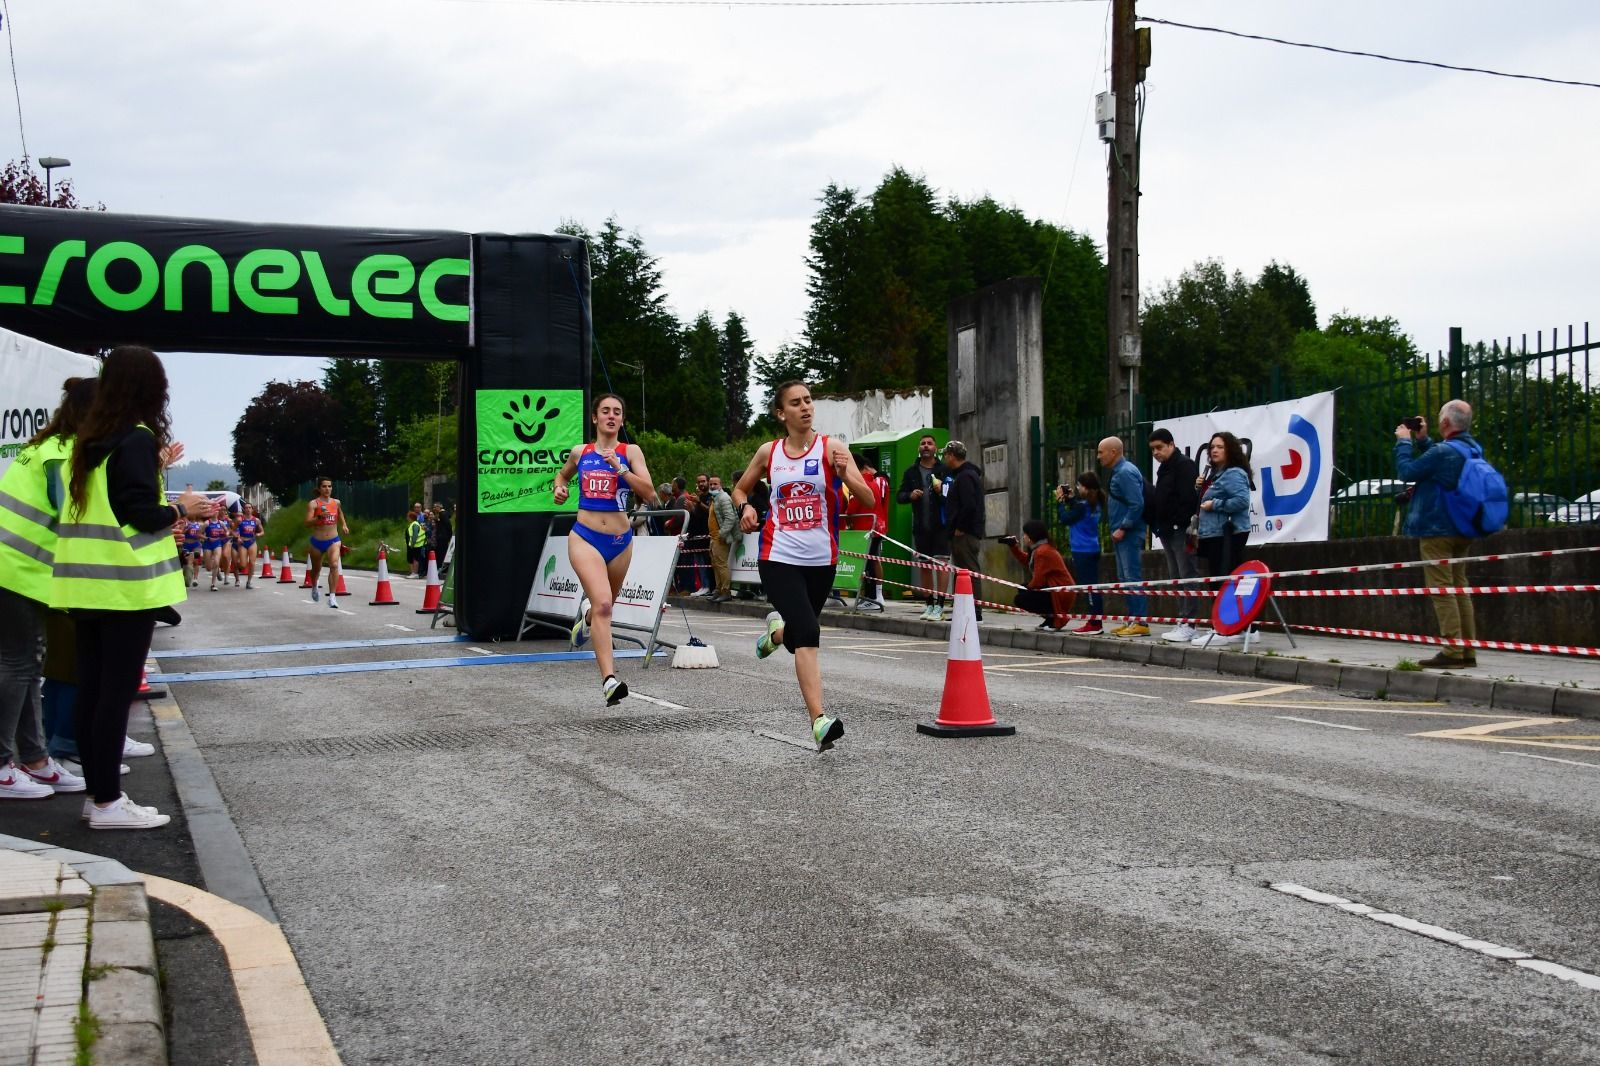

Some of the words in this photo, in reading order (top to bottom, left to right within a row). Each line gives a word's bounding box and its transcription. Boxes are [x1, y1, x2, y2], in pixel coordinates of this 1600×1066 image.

[479, 449, 571, 465] cronele
[479, 467, 523, 475] EVENTOS
[590, 479, 609, 491] 012
[481, 488, 514, 502] Pasión
[518, 487, 533, 499] por
[786, 505, 813, 521] 006
[550, 577, 564, 594] Unicaja
[564, 579, 578, 593] Banco
[636, 585, 654, 600] Banco
